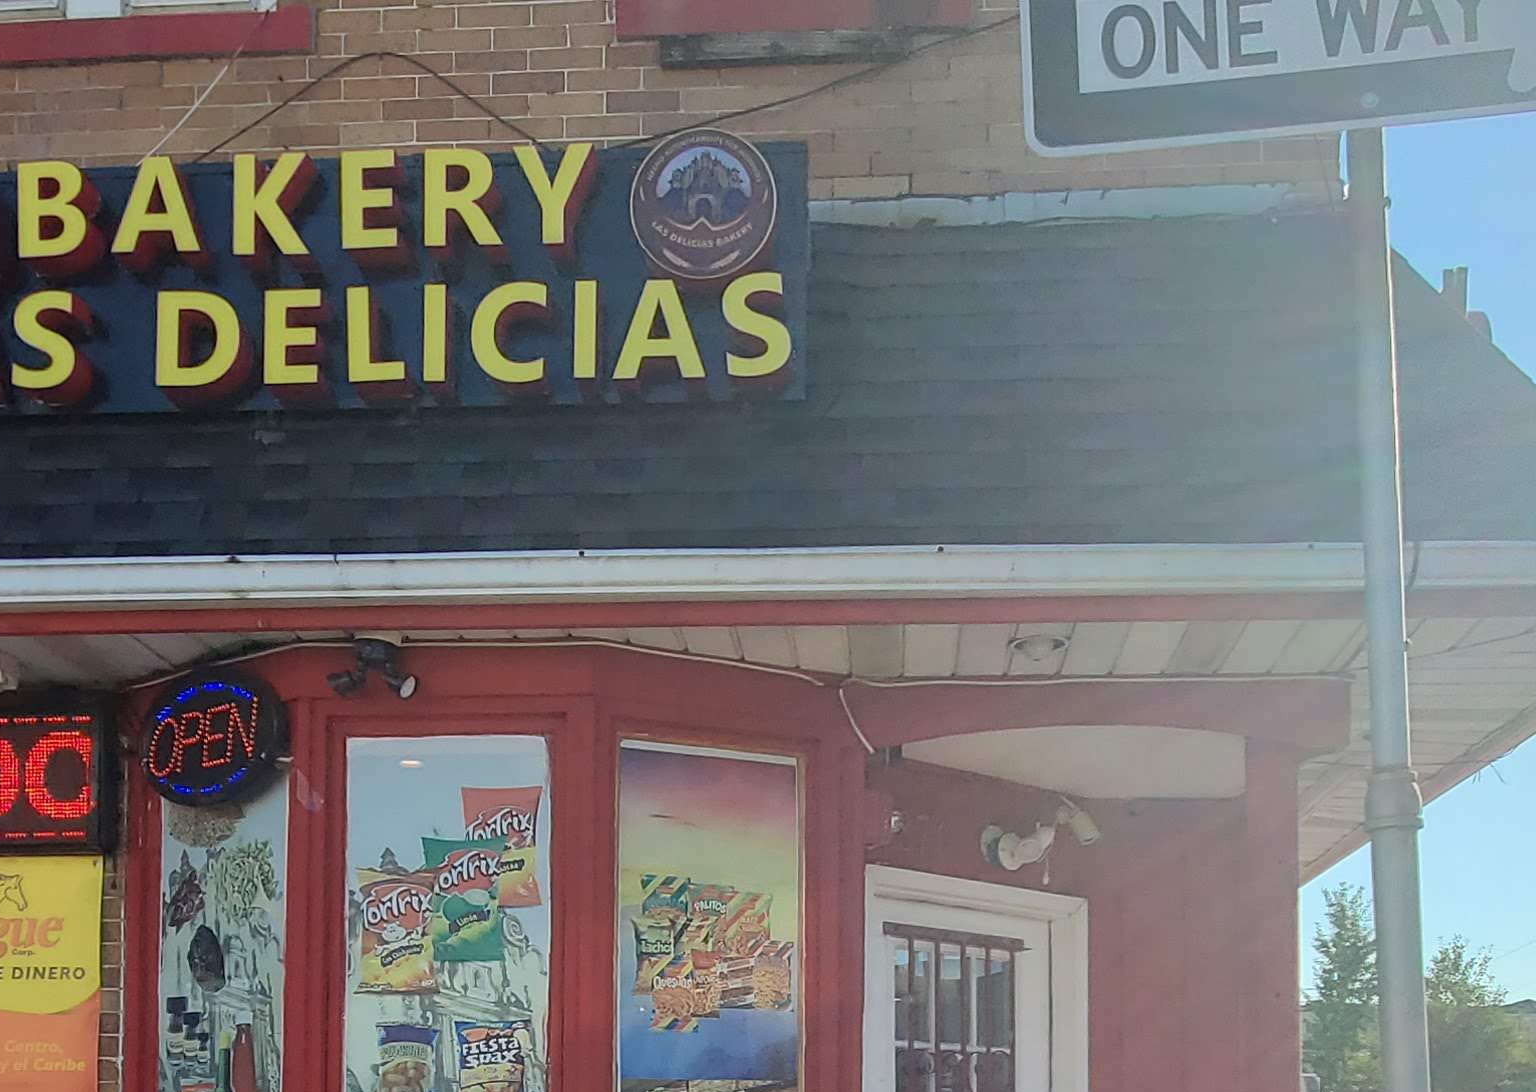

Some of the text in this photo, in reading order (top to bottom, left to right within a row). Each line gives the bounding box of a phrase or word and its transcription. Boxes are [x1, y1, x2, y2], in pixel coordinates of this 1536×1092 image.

[1101, 0, 1278, 79] ONE
[16, 142, 596, 260] BAKERY
[652, 221, 753, 248] LAS DELICIAS BAKERY
[155, 271, 793, 388] DELICIAS
[149, 696, 258, 777] OPEN
[361, 886, 434, 926] TorTrix
[11, 947, 35, 957] Corp.
[11, 966, 86, 980] DINERO
[0, 1060, 9, 1074] y
[15, 1057, 29, 1072] el
[33, 1057, 86, 1072] Caribe
